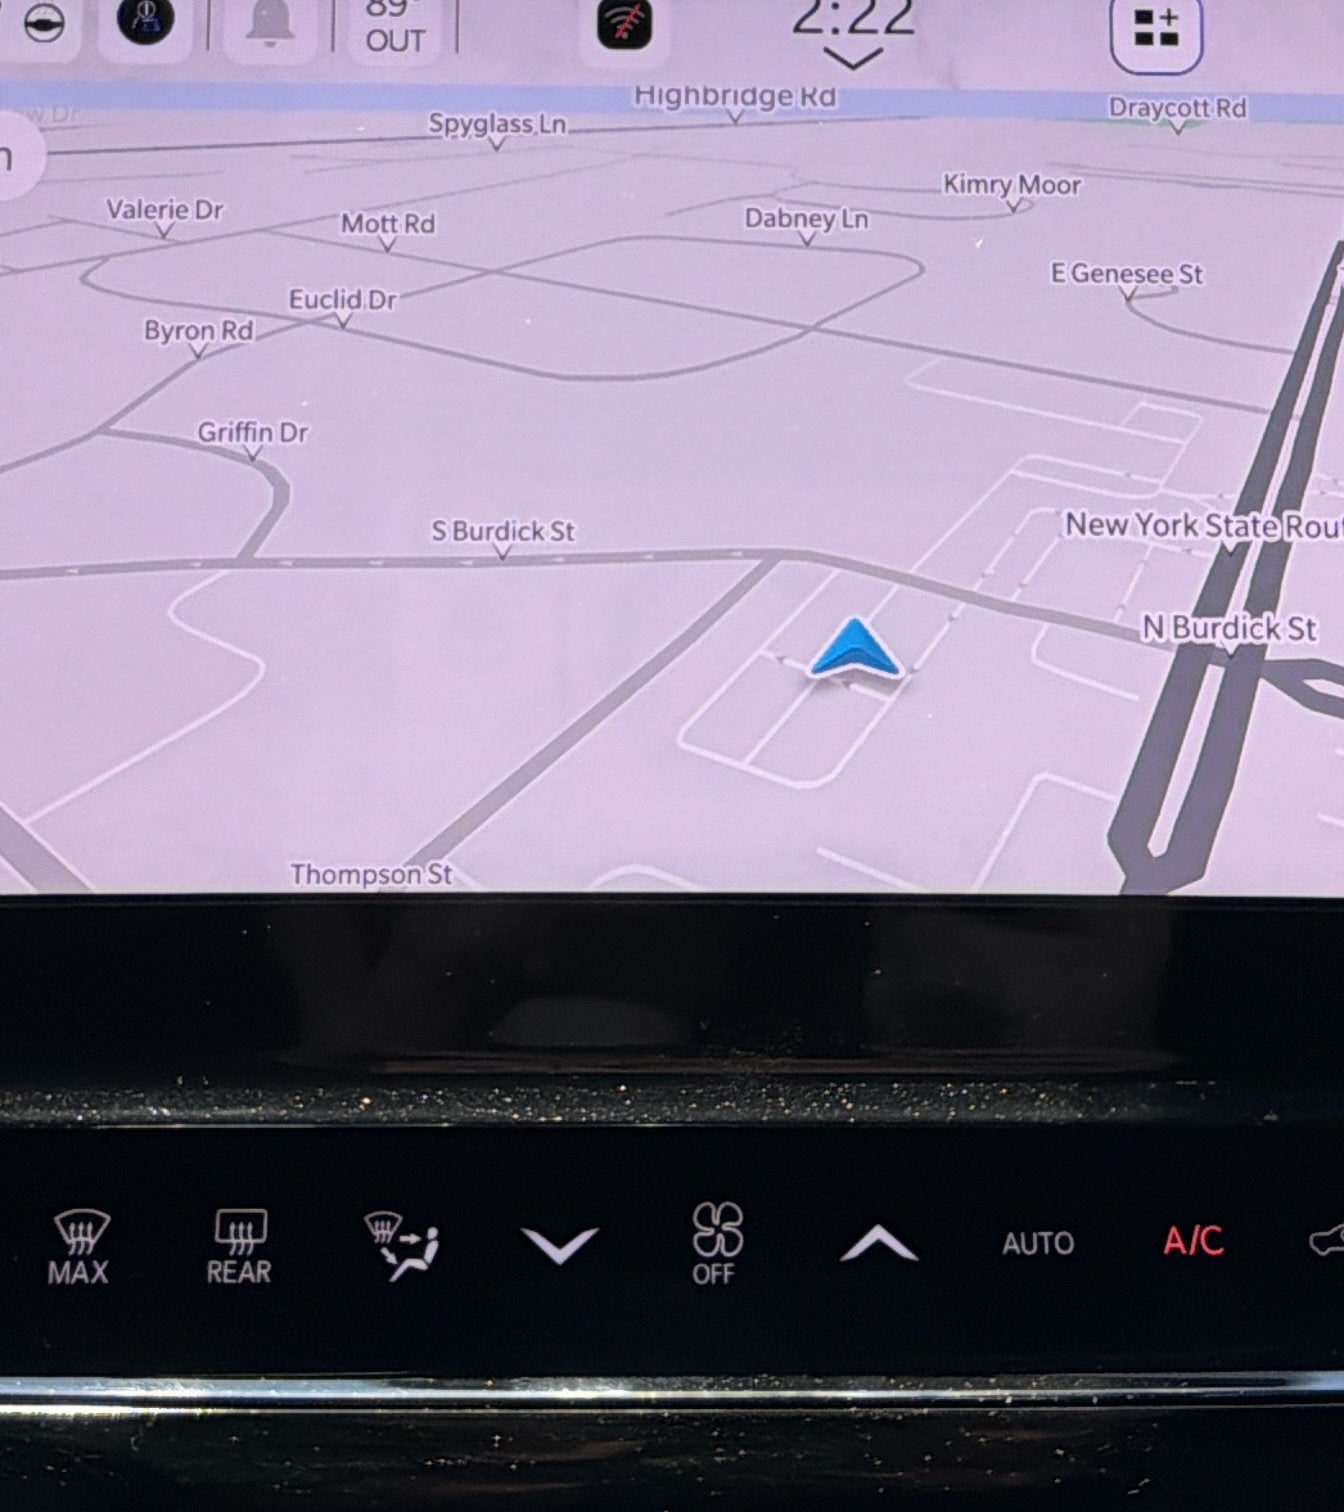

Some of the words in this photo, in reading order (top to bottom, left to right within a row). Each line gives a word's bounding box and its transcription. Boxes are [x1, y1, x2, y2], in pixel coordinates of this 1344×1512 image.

[365, 28, 427, 53] OUT
[635, 86, 794, 111] Highbridge
[801, 86, 836, 107] Rd
[1110, 97, 1210, 123] Draycott
[1216, 97, 1248, 119] Rd
[429, 112, 533, 139] Spyglass
[540, 114, 567, 135] Ln
[944, 173, 1013, 199] Kimry
[1019, 174, 1082, 196] Moor
[106, 198, 188, 221] Valerie
[196, 199, 224, 221] Dr
[745, 206, 835, 234] Dabney
[842, 208, 869, 230] Ln
[341, 213, 399, 234] Mott
[405, 213, 436, 235] Rd
[1052, 262, 1066, 284] E
[1071, 262, 1173, 286] Genesee
[1178, 262, 1204, 286] St
[289, 288, 362, 311] Euclid
[369, 289, 398, 311] Dr
[145, 319, 215, 347] Byron
[222, 319, 255, 342] Rd
[197, 420, 273, 444] Griffin
[279, 422, 310, 444] Dr
[432, 519, 447, 542] S
[453, 519, 545, 542] Burdick
[551, 520, 576, 542] St
[1066, 512, 1128, 538] New
[1134, 512, 1199, 537] York
[1205, 513, 1279, 538] State
[1143, 614, 1165, 640] N
[1172, 614, 1282, 642] Burdick
[1287, 616, 1318, 643] St
[290, 861, 423, 890] Thompson
[428, 862, 453, 886] St
[1001, 1229, 1076, 1257] AUTO
[1162, 1224, 1226, 1257] A/C
[47, 1260, 110, 1286] MAX
[206, 1259, 273, 1285] REAR
[691, 1262, 736, 1286] OFF
